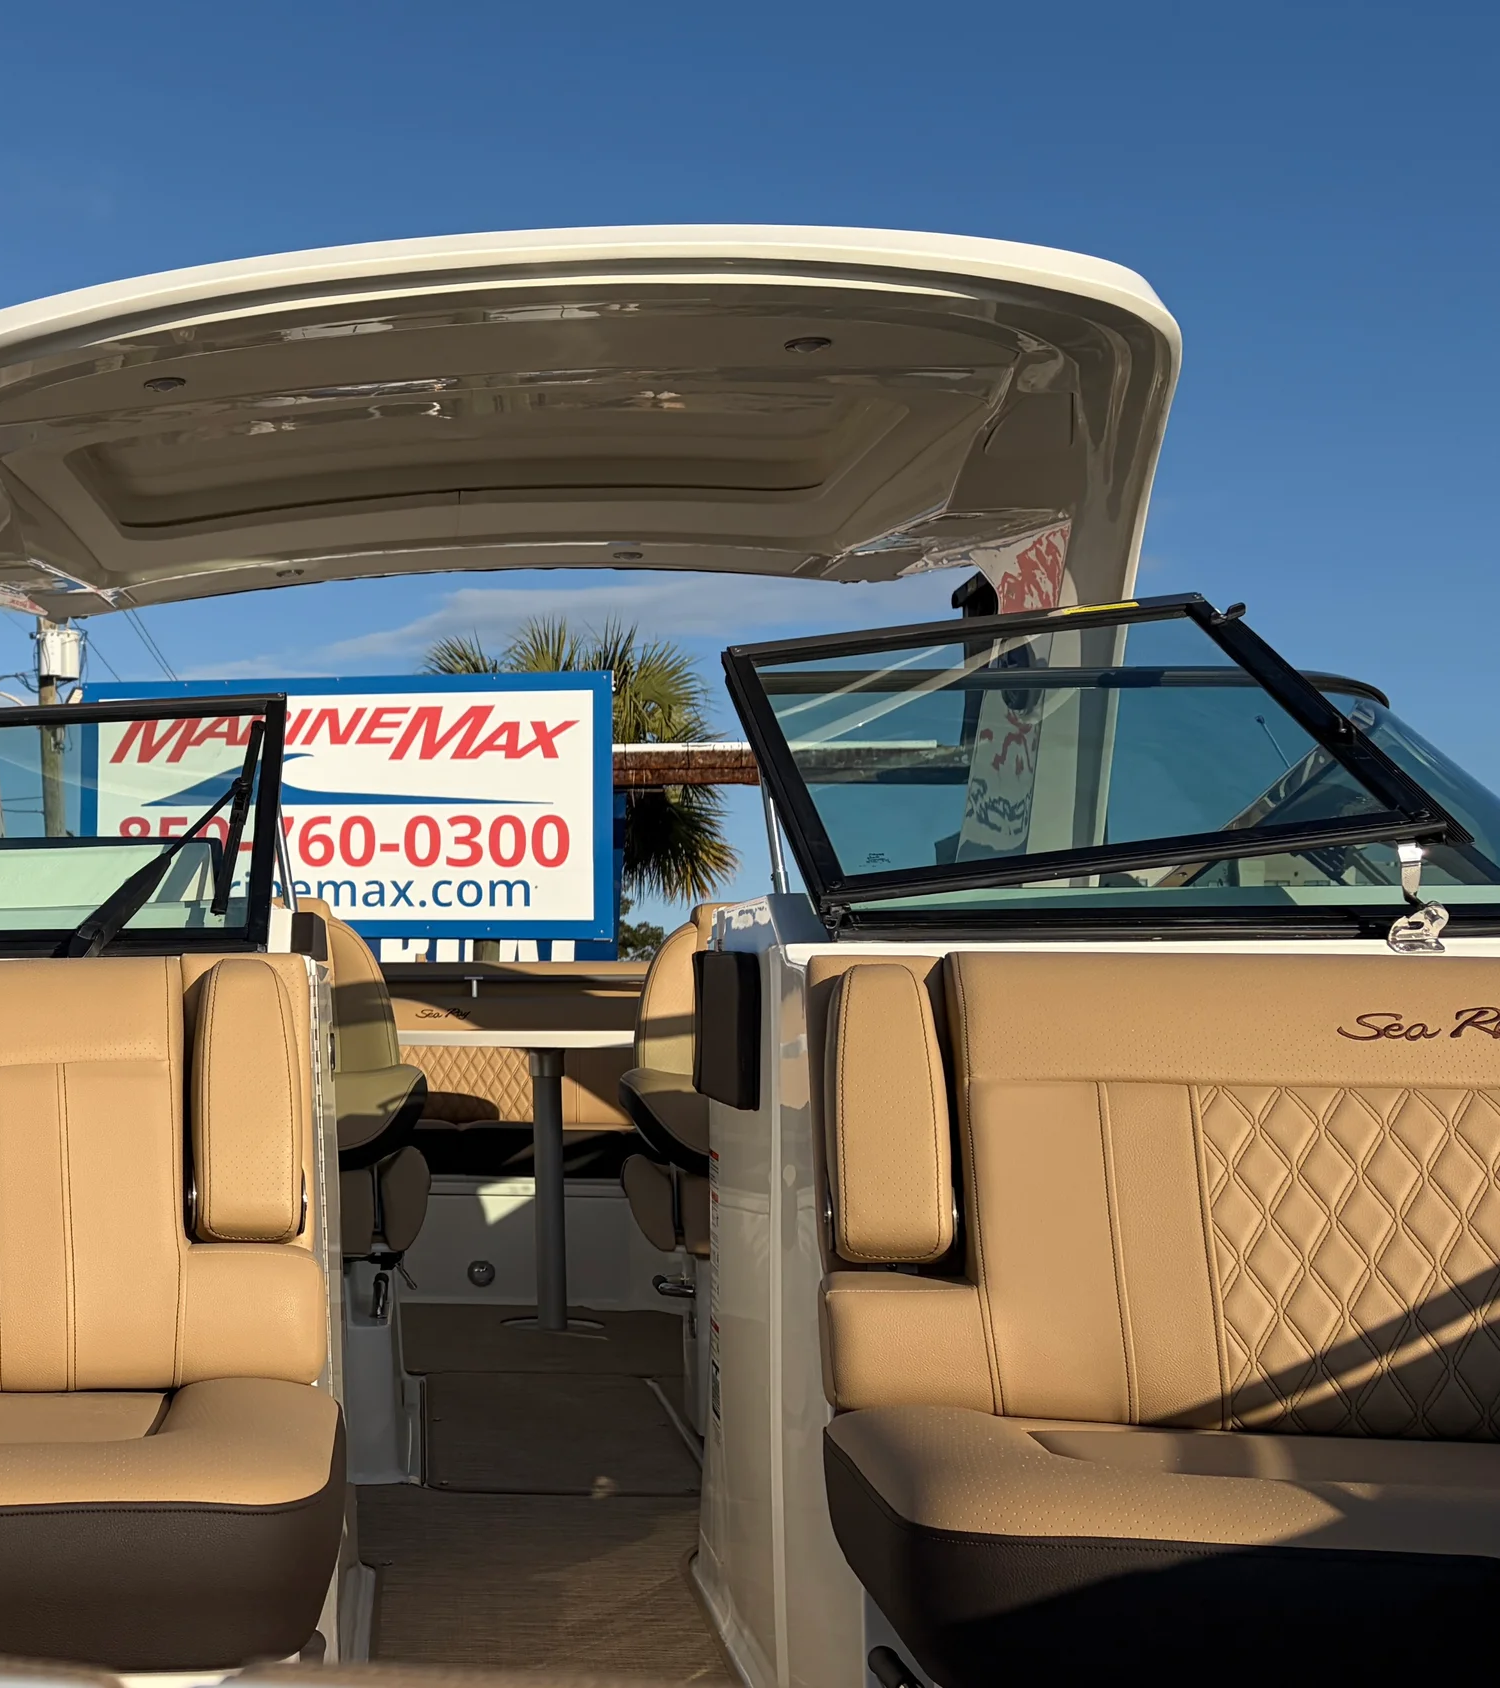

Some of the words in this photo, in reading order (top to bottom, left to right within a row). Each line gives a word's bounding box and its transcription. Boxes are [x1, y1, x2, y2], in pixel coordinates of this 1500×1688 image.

[109, 704, 581, 764] MAINEMAX
[119, 814, 570, 868] -60-0300
[415, 1008, 443, 1019] Sea
[444, 1007, 472, 1020] Ray
[1336, 1012, 1442, 1041] Sea
[1450, 1006, 1500, 1039] R
